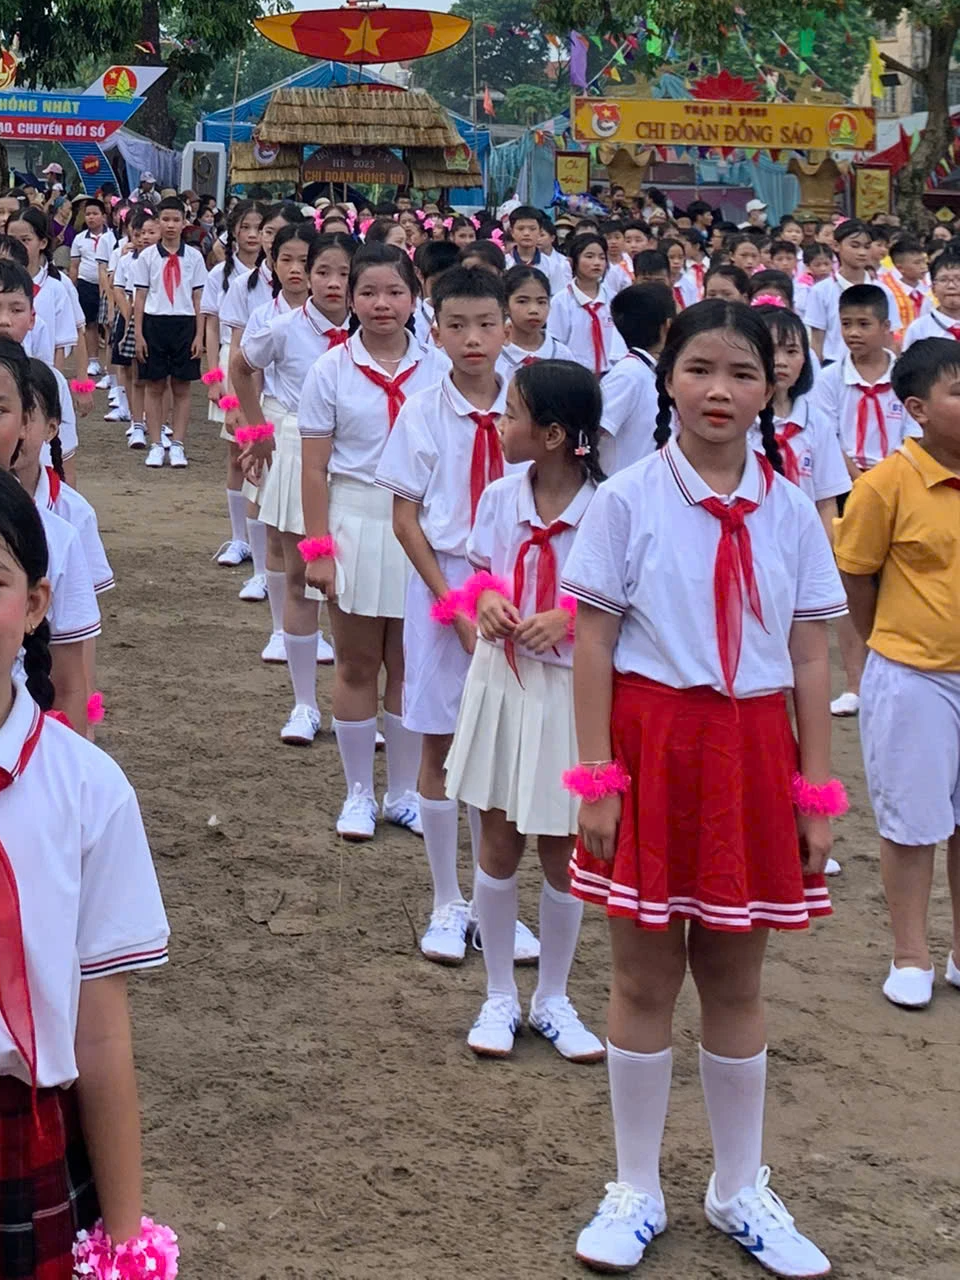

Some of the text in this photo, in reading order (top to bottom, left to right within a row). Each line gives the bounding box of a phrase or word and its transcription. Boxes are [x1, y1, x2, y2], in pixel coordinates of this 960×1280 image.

[90, 122, 106, 138] SỐ
[635, 121, 665, 140] CHI
[671, 119, 719, 141] ĐOÀN
[353, 159, 376, 169] 2023
[304, 170, 321, 182] CHI
